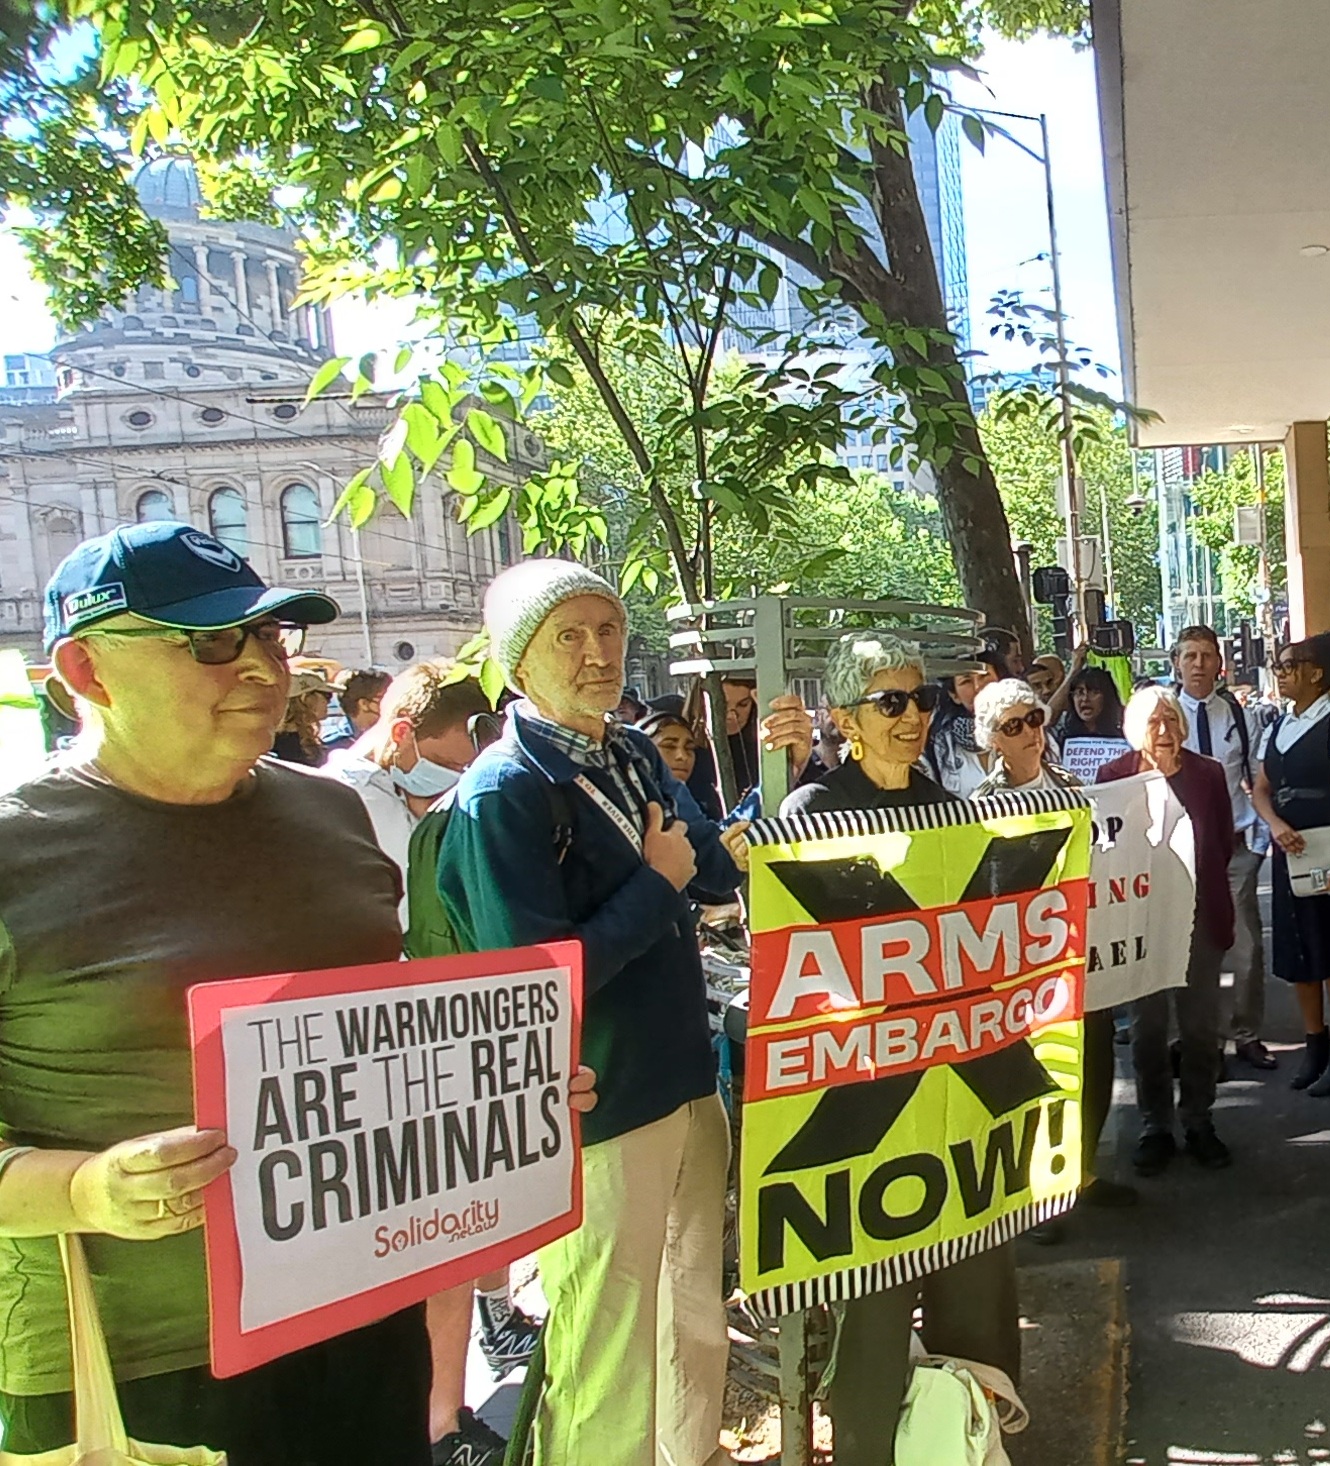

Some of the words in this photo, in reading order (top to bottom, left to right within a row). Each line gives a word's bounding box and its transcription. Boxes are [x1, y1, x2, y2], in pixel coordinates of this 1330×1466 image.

[69, 591, 111, 611] Dulux
[1066, 747, 1105, 756] DEFEND
[1070, 757, 1102, 766] RIGHT
[1070, 768, 1098, 777] PROT
[1087, 873, 1150, 909] ING
[766, 890, 1070, 1020] ARMS
[1087, 936, 1147, 973] AEL
[247, 1012, 327, 1073] THE
[336, 980, 559, 1058] WARMONGERS
[765, 974, 1070, 1092] EMBARGO
[253, 1062, 362, 1151] ARE
[373, 1046, 458, 1120] THE
[471, 1027, 562, 1100] REAL
[258, 1086, 562, 1243] CRIMINALS
[757, 1099, 1067, 1276] NOW!
[374, 1198, 499, 1259] Solidarity
